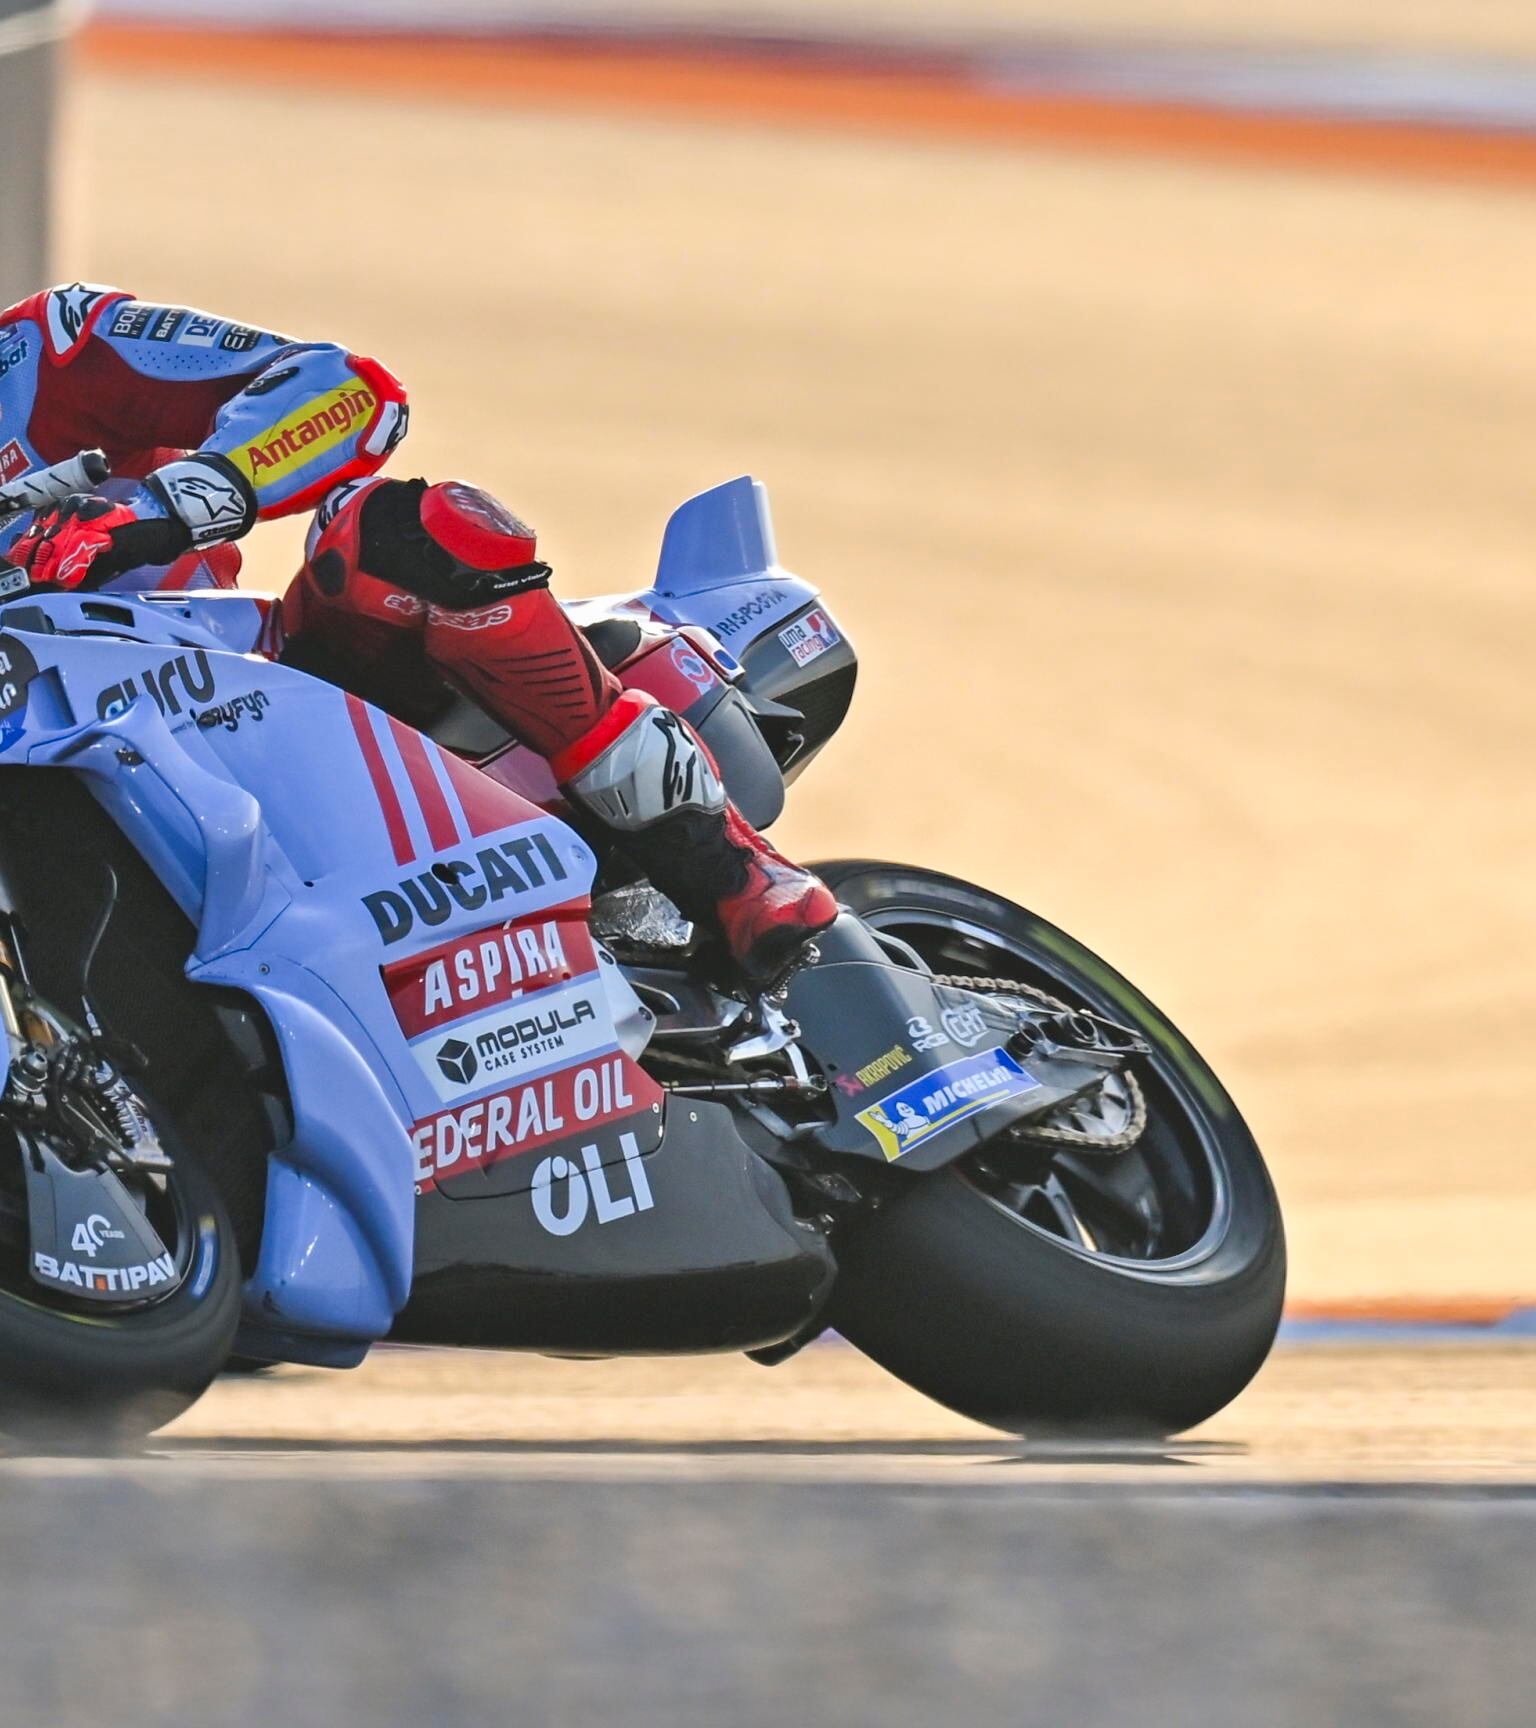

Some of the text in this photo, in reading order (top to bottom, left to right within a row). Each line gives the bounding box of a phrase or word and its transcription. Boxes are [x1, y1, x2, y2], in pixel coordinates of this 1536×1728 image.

[247, 389, 375, 475] Antangin
[716, 588, 788, 637] RISPOSTA
[779, 624, 807, 649] uma
[360, 833, 568, 947] DUCATI
[476, 1000, 596, 1059] MODULA
[484, 1035, 565, 1072] CASE SYSTEM
[573, 1058, 633, 1122] OIL
[530, 1131, 654, 1237] OLI
[34, 1252, 175, 1291] BATTIPAV
